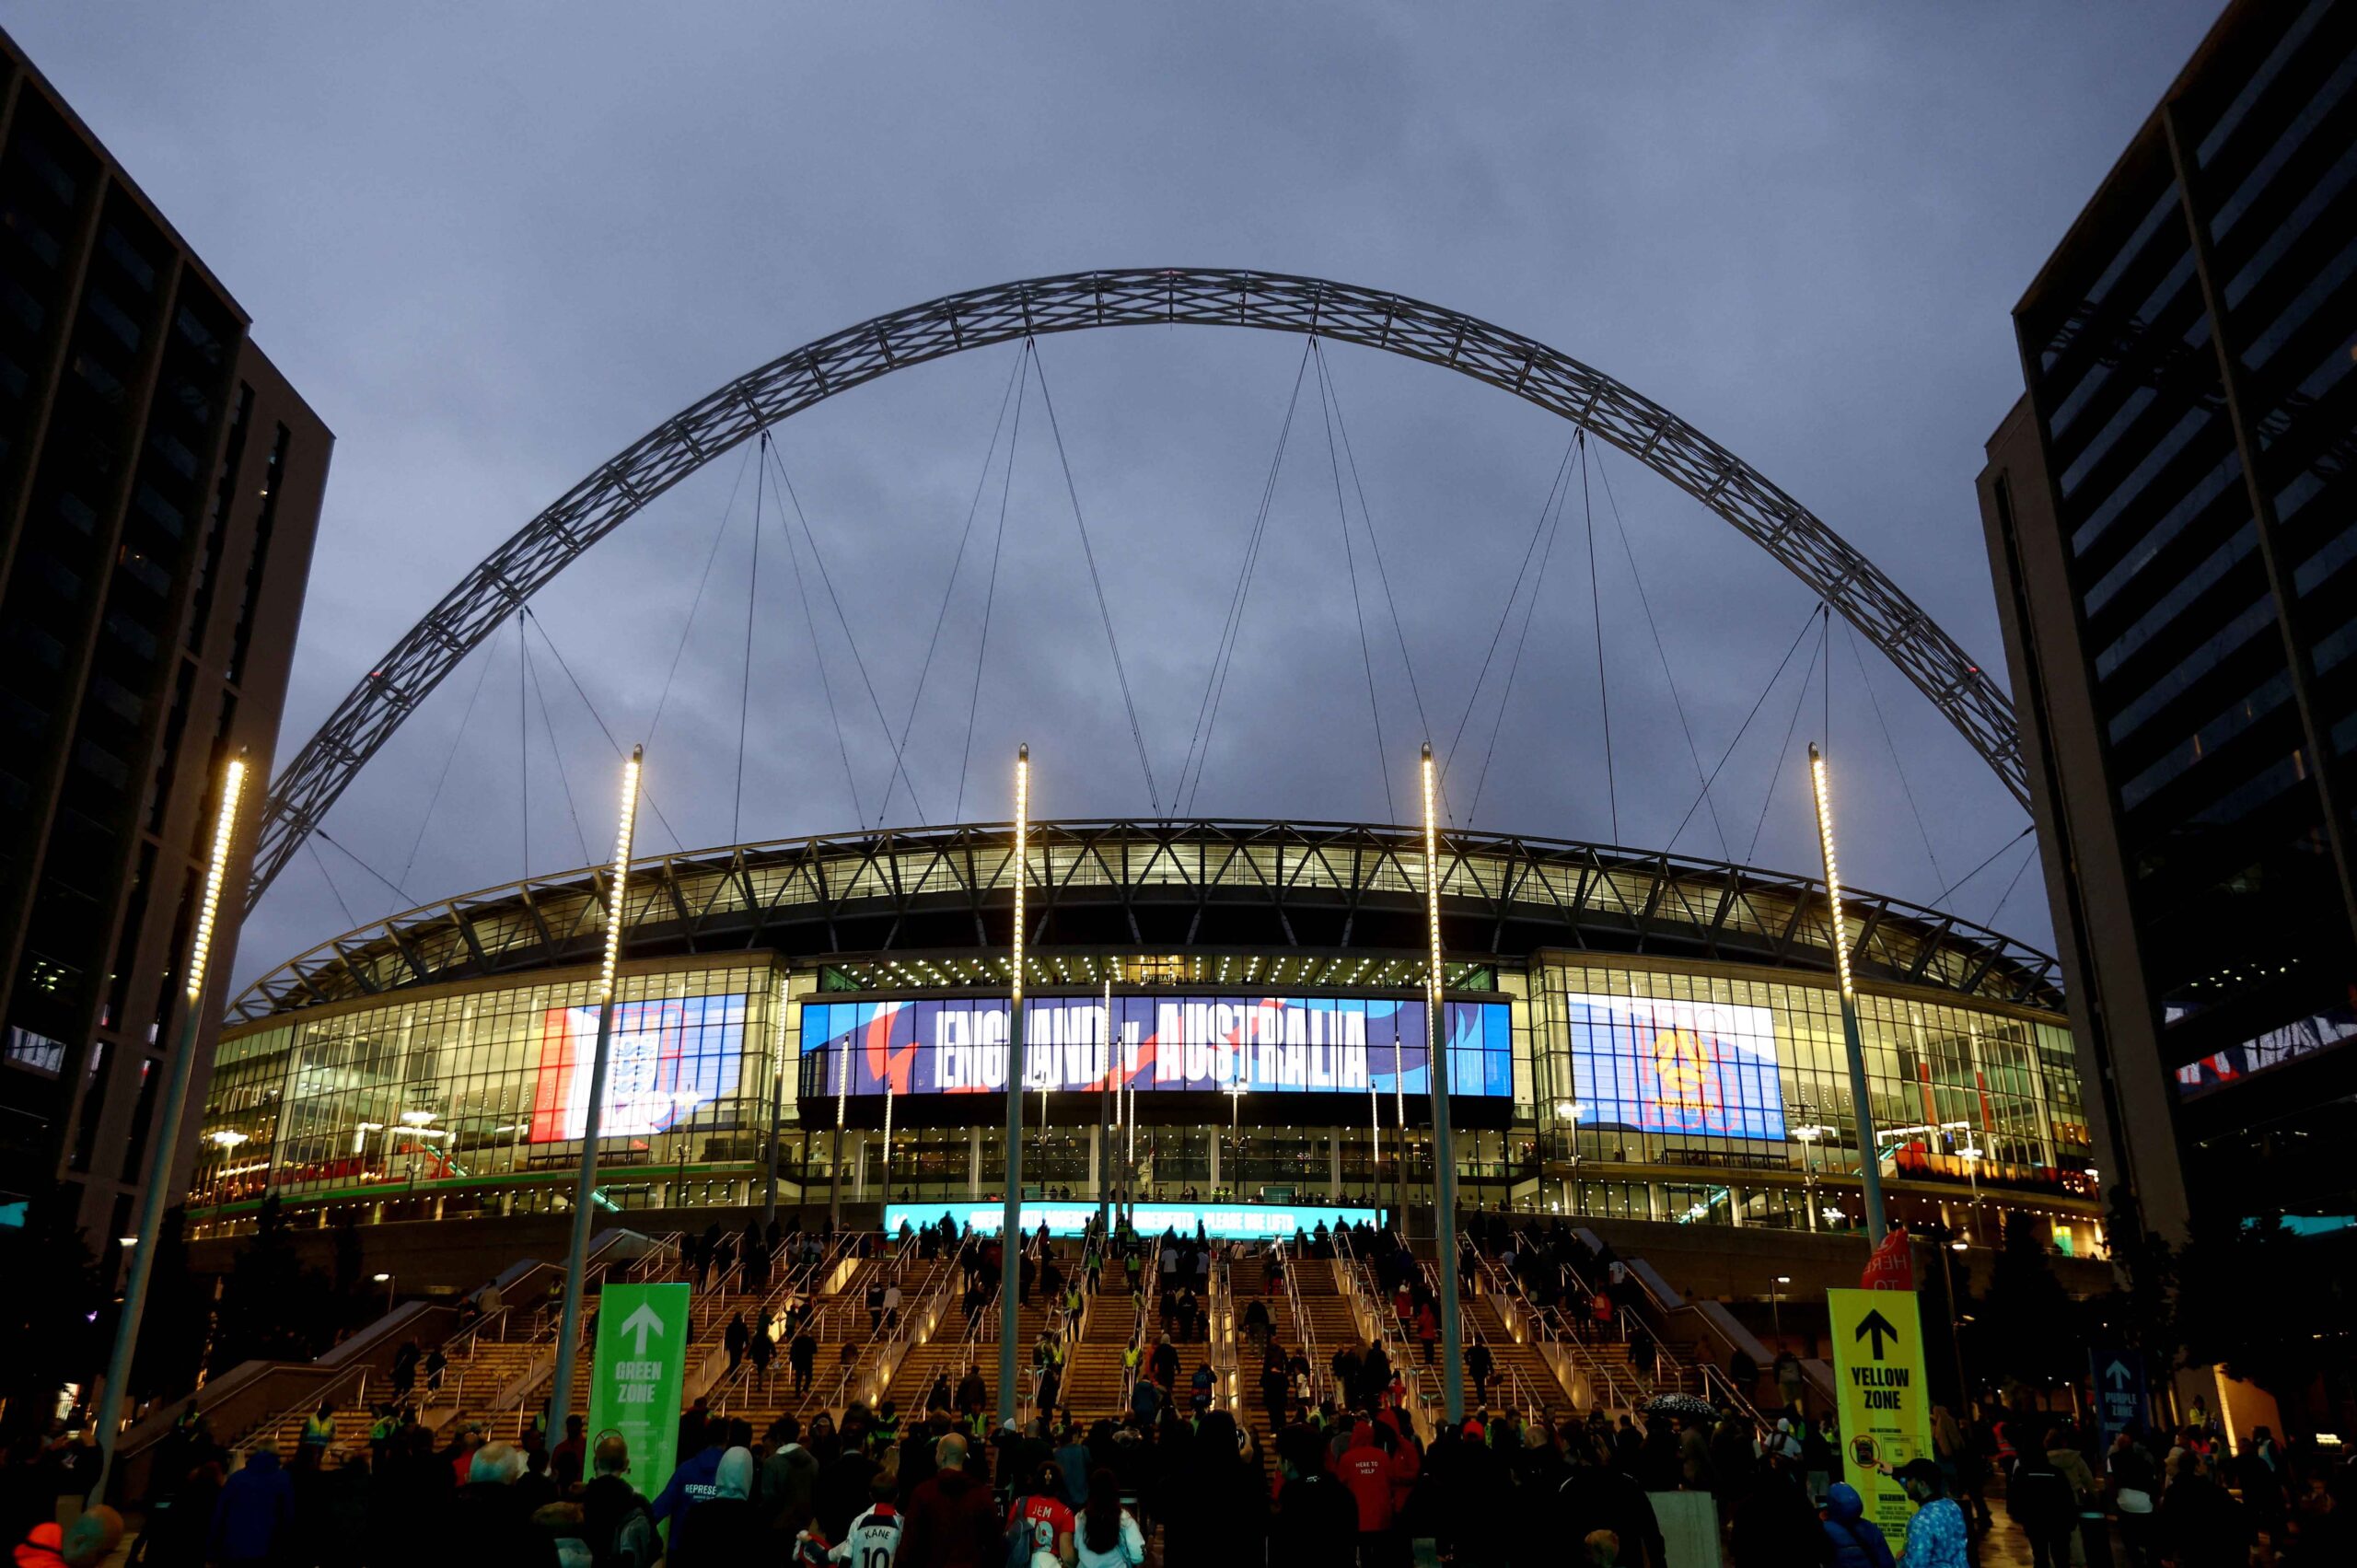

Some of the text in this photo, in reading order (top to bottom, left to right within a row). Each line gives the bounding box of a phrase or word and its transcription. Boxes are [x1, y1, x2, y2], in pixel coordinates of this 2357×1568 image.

[1155, 1004, 1367, 1088] AUSTRALIA
[616, 1361, 662, 1380] GREEN
[1852, 1366, 1910, 1388] YELLOW
[618, 1383, 656, 1403] ZONE
[1864, 1390, 1901, 1410] ZONE
[2105, 1391, 2138, 1405] PURPLE
[2111, 1405, 2134, 1417] ZONE
[685, 1483, 717, 1495] REPRESE
[1032, 1503, 1052, 1518] JEM
[865, 1528, 890, 1540] KANE
[862, 1546, 890, 1568] 10
